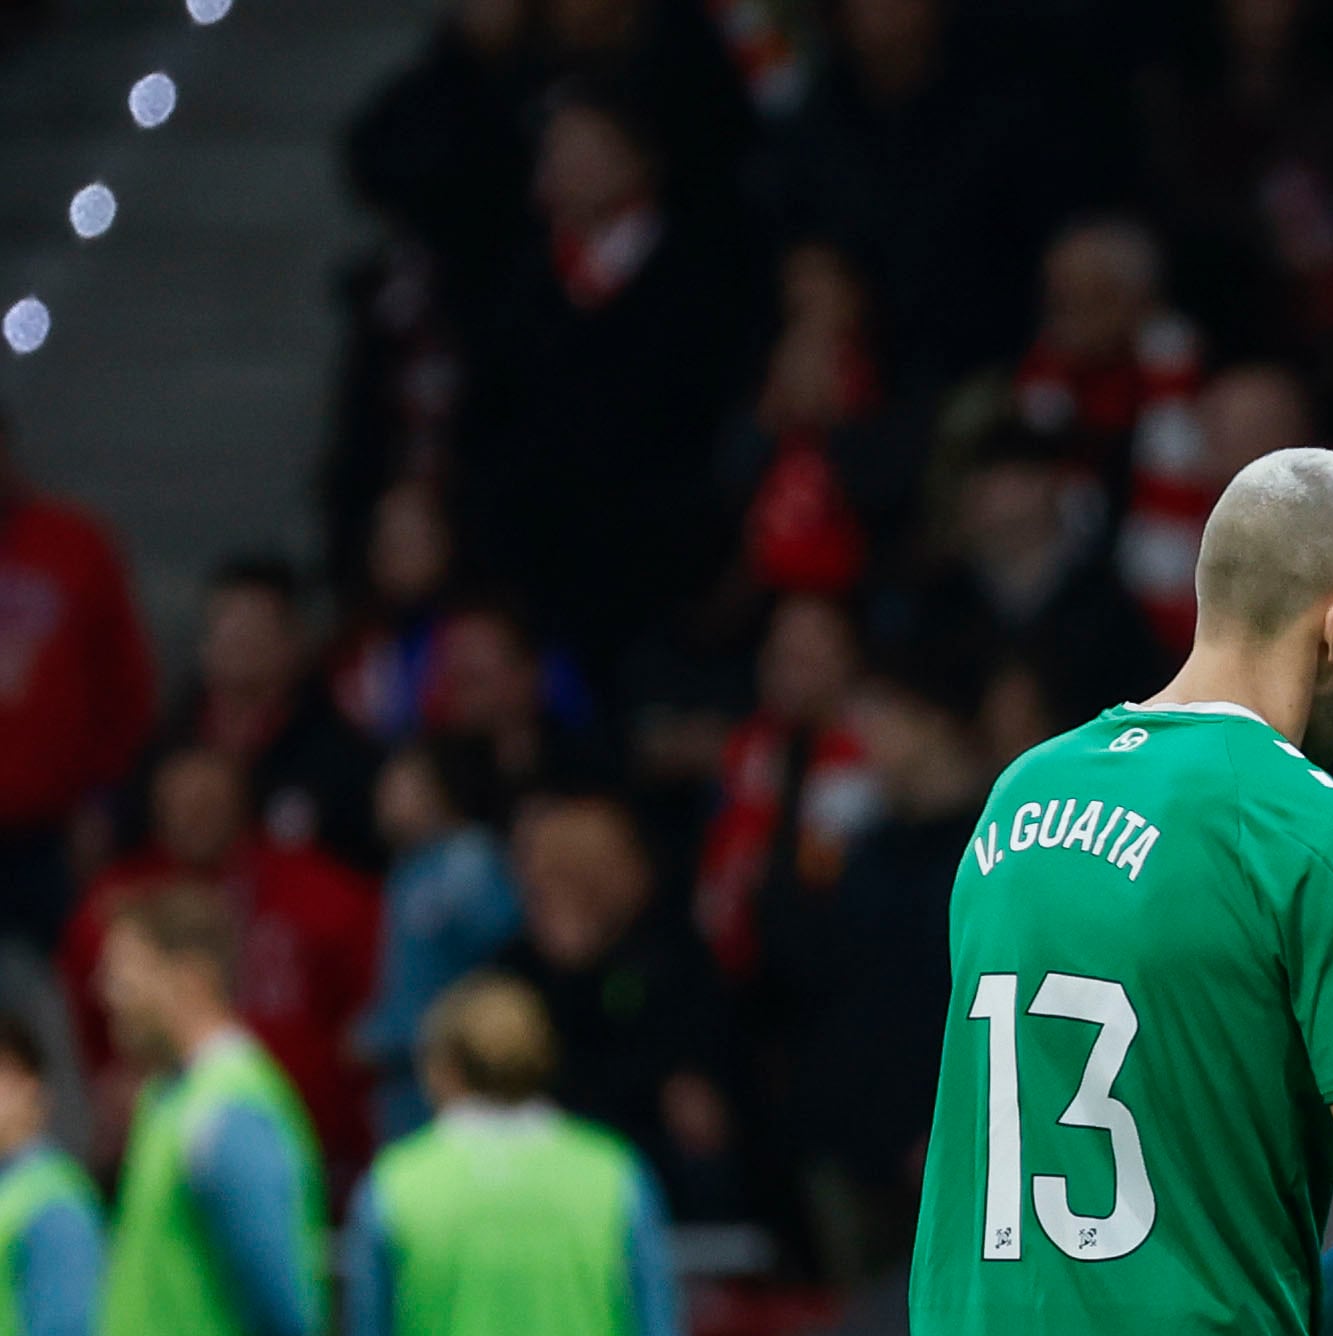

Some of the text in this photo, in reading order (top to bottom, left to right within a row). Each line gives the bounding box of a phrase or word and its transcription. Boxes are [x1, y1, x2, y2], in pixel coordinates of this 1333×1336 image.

[974, 798, 1161, 882] V. GUAITA
[968, 970, 1157, 1261] 13
